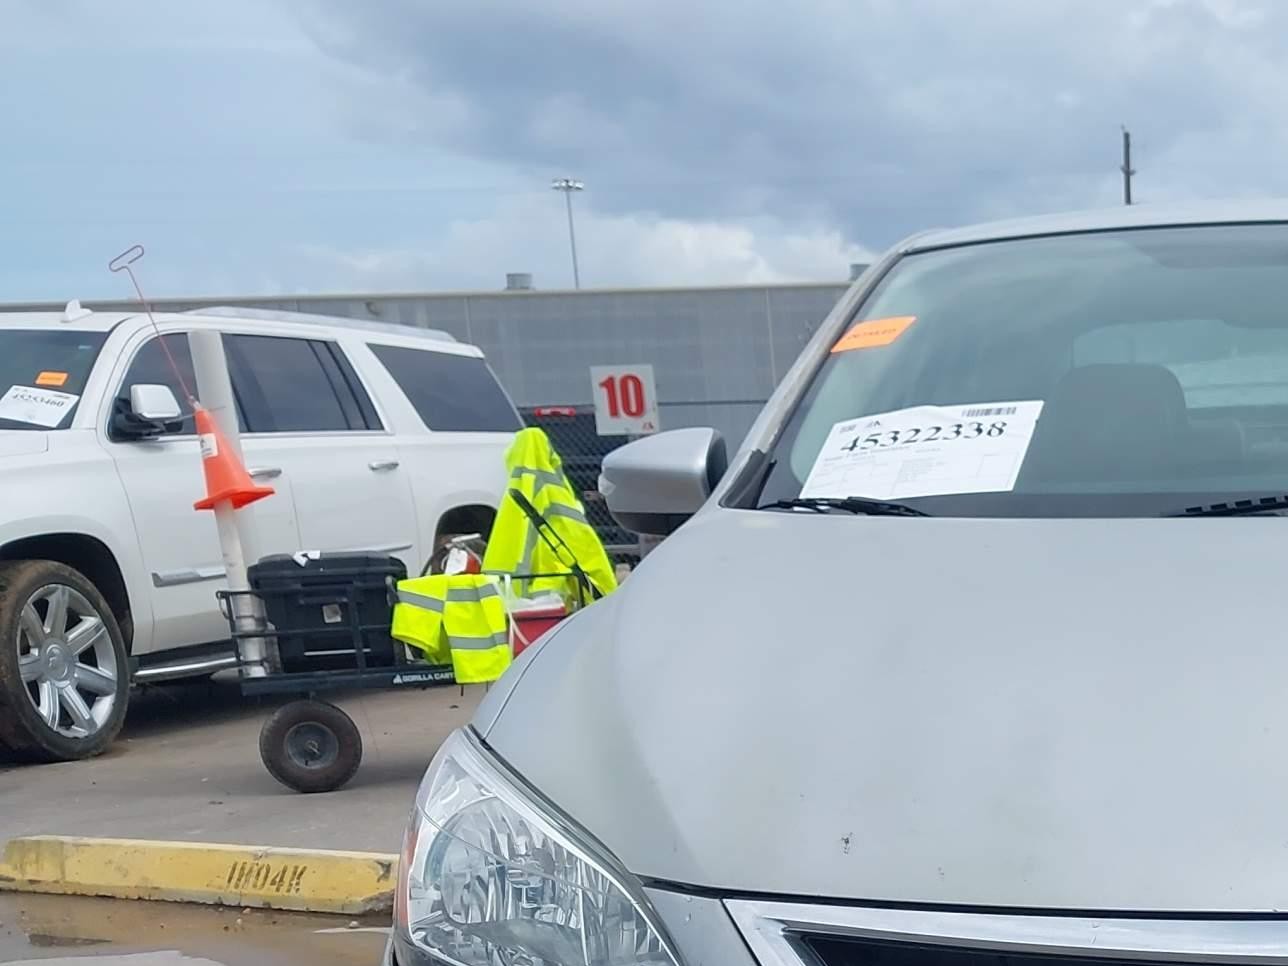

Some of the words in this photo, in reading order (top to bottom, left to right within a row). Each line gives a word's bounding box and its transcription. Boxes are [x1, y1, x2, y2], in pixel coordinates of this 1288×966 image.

[599, 374, 645, 418] 10
[840, 420, 1008, 452] 45322338
[402, 673, 434, 682] GORILLA
